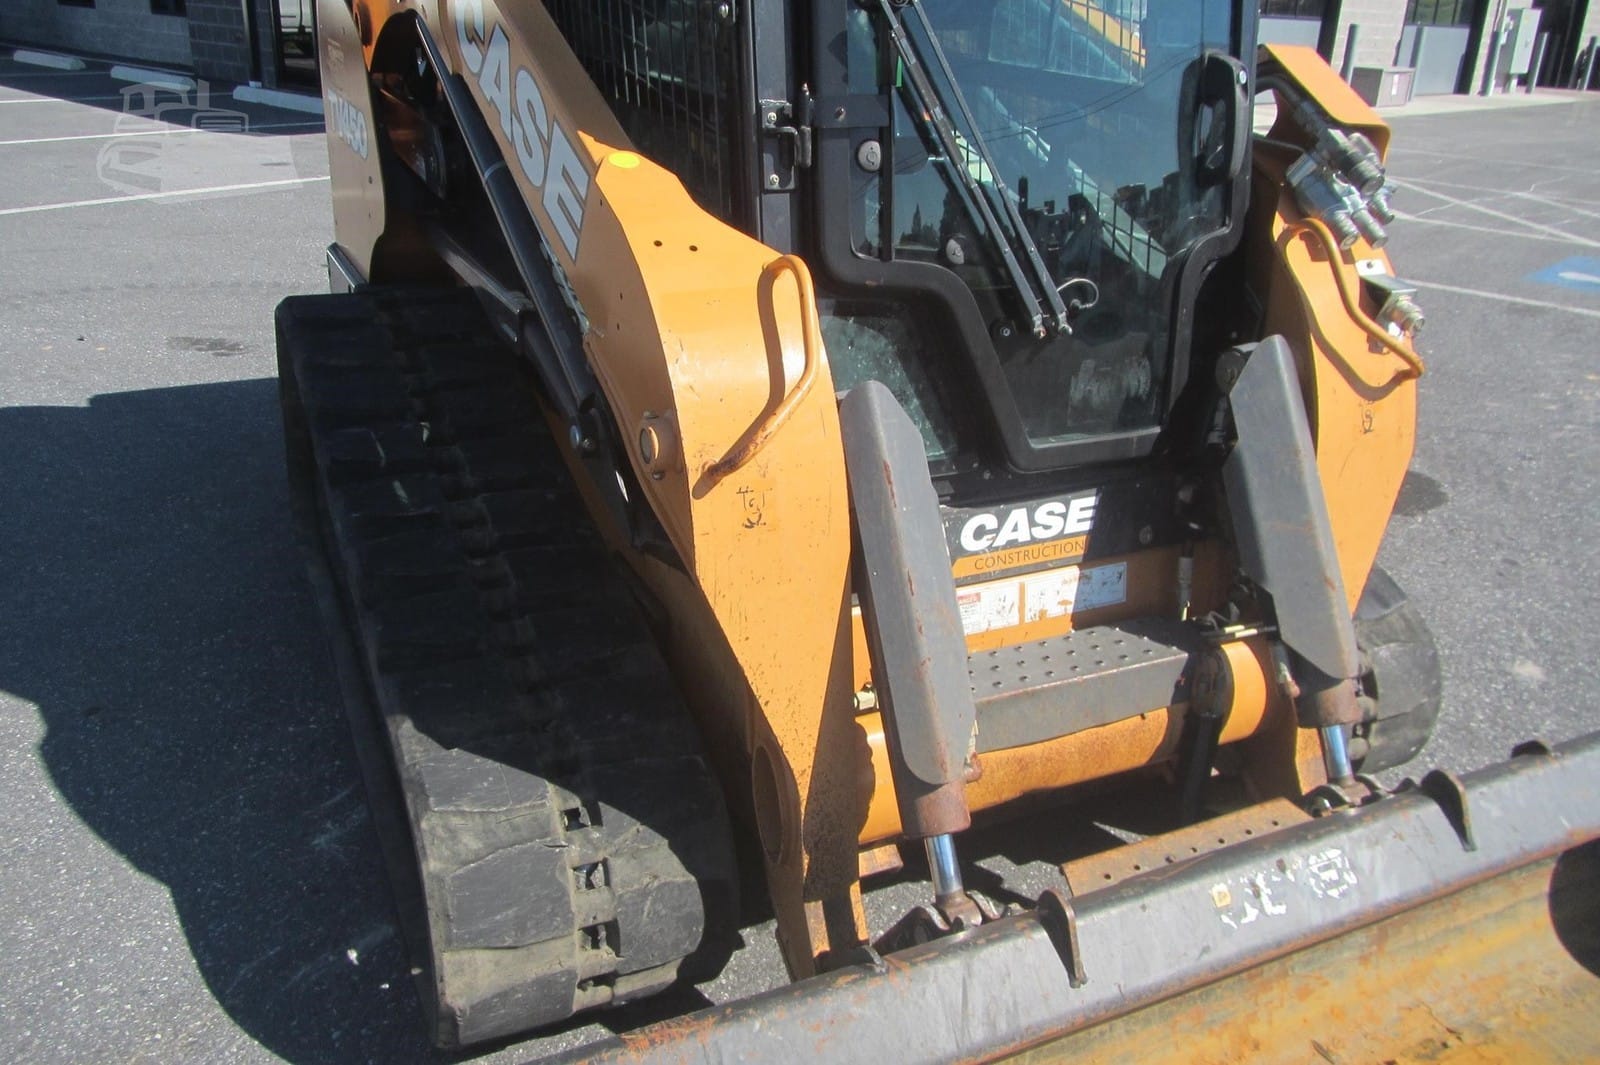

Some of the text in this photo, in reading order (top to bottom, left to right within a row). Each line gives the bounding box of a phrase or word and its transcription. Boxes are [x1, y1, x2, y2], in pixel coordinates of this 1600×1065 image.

[455, 0, 590, 262] CASE
[960, 496, 1096, 552] CASE
[974, 541, 1084, 571] CONSTRUCTION
